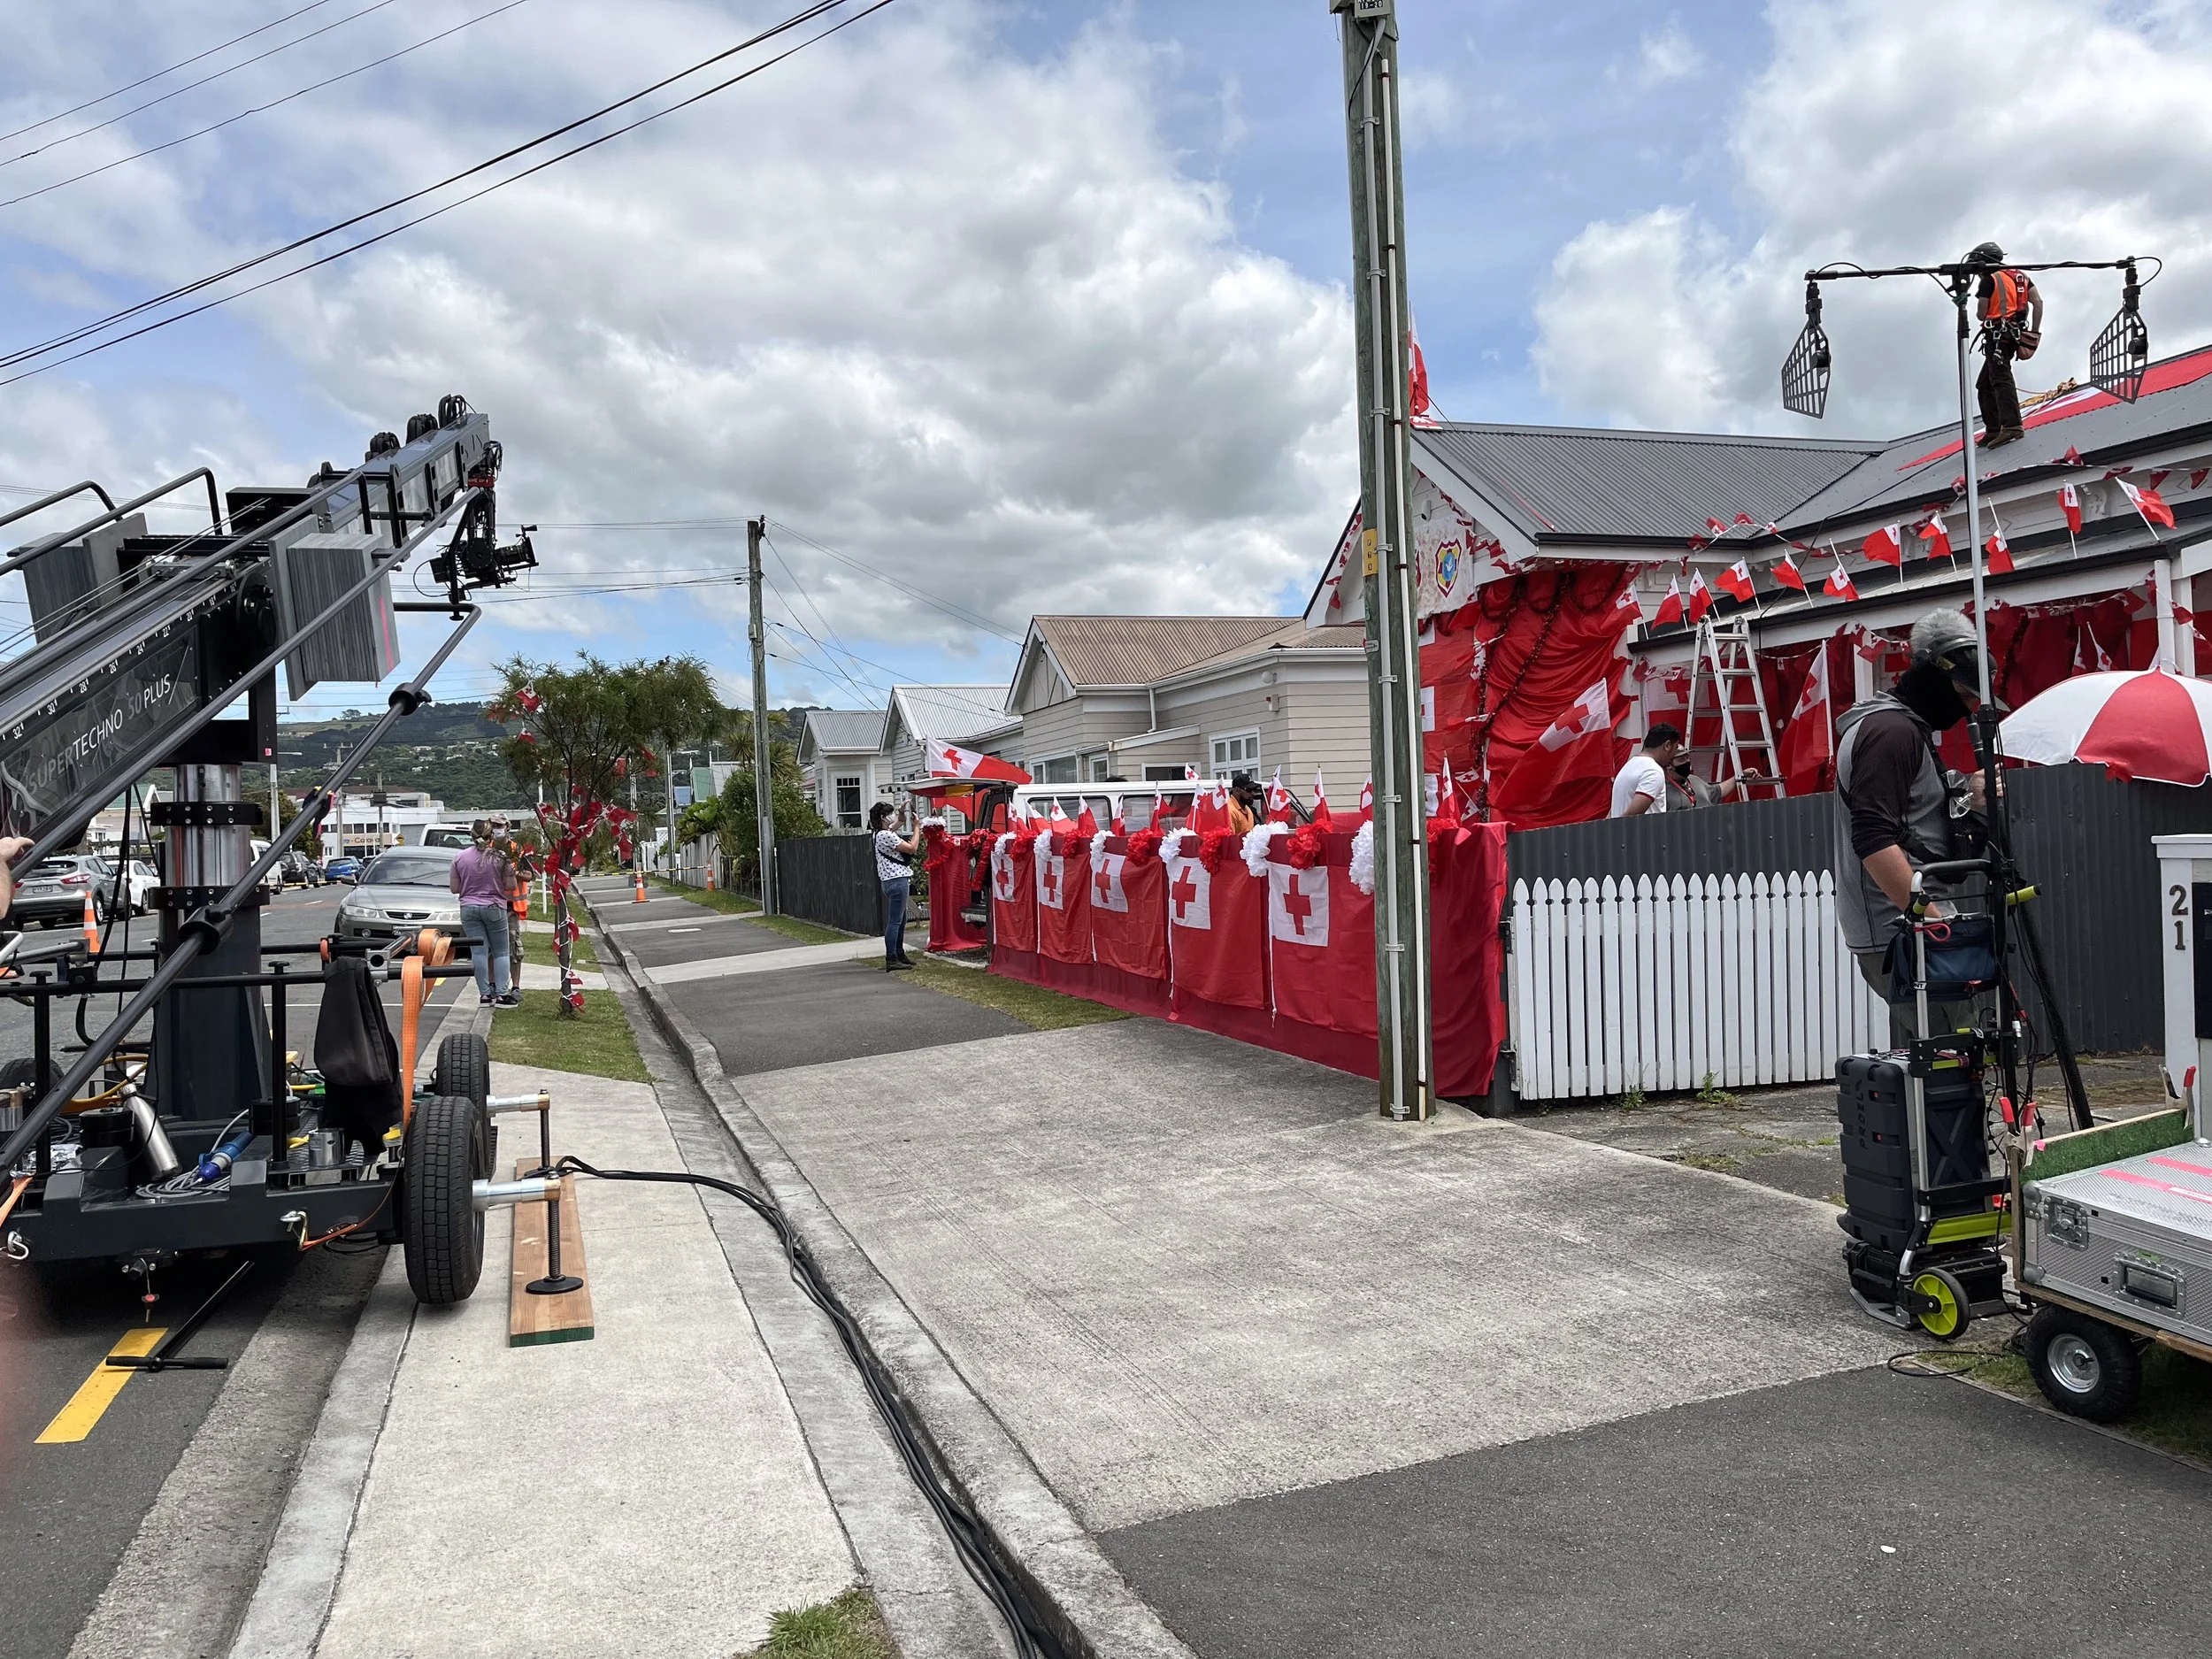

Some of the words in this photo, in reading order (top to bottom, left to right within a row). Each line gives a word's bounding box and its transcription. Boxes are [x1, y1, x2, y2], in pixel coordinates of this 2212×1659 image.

[128, 692, 142, 720] 50
[143, 673, 171, 709] PLUS
[2169, 884, 2189, 951] 21
